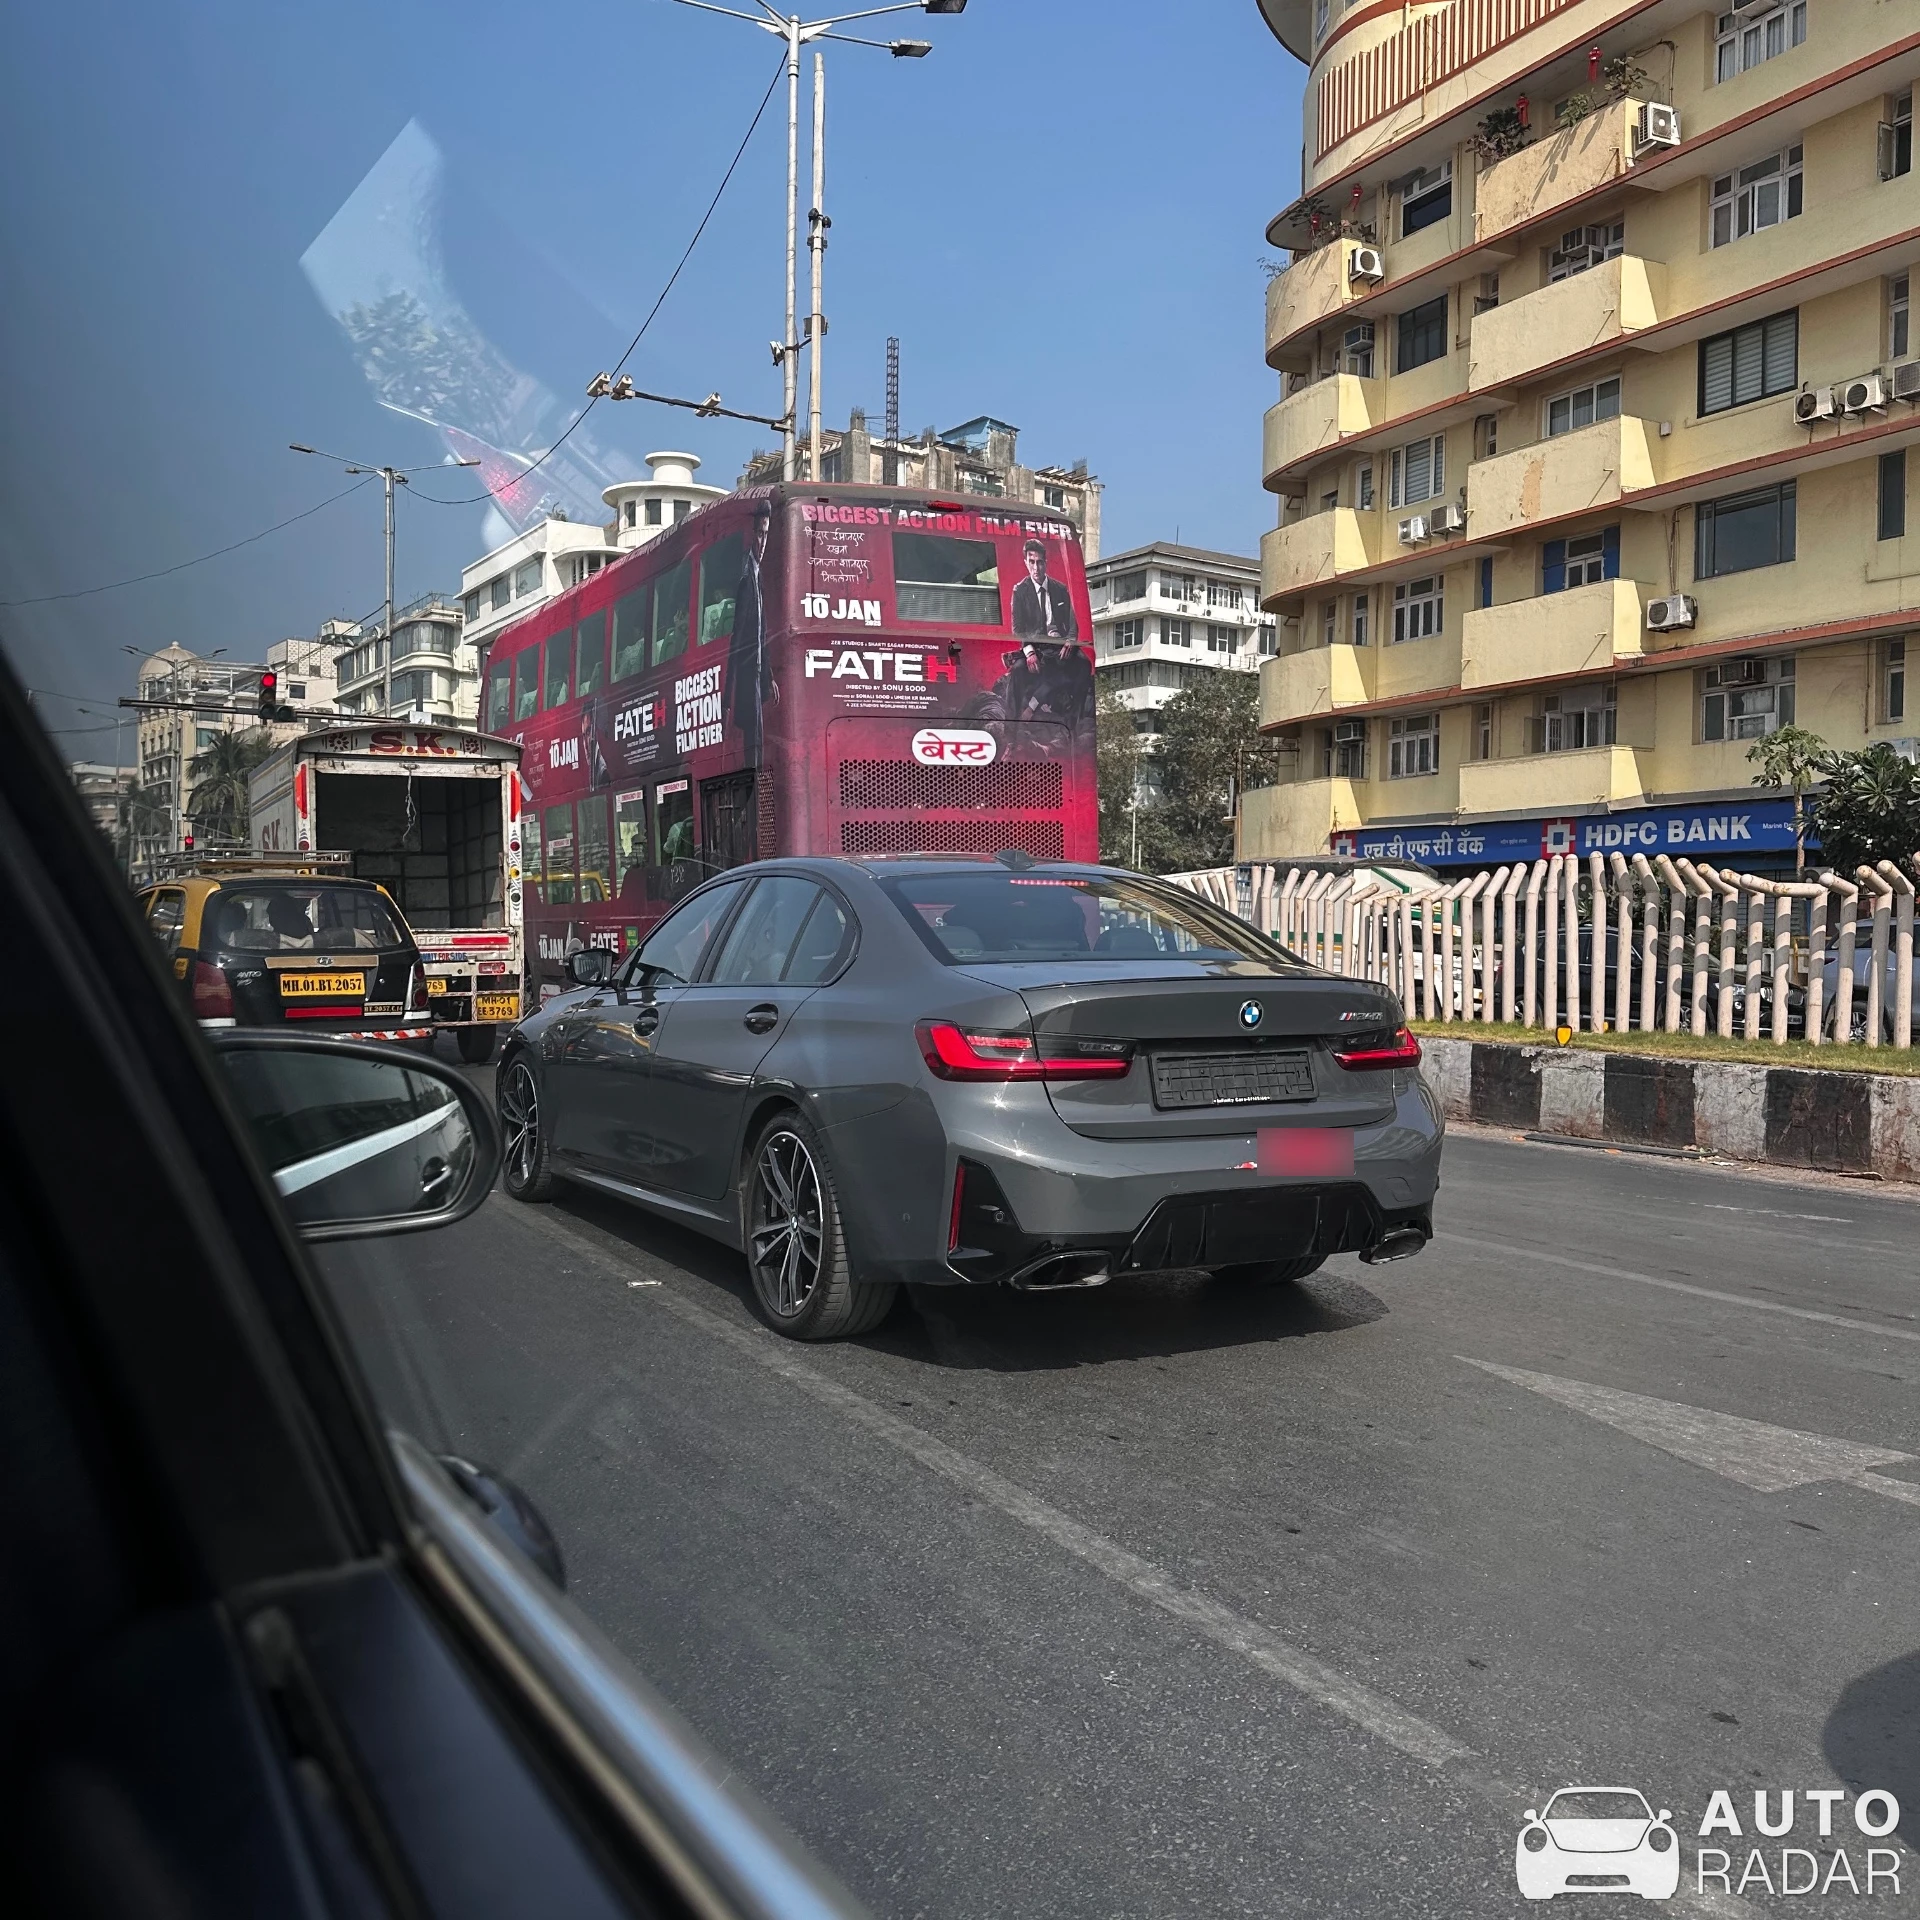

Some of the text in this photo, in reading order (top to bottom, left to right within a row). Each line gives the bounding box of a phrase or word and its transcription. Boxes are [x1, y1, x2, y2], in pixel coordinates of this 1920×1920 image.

[802, 504, 1073, 541] BIGGEST ACTION FILM EVER
[800, 597, 882, 621] 10 JAN
[905, 643, 940, 651] PRODUCTIONS
[805, 648, 958, 683] FATEH
[675, 664, 722, 705] BIGGEST
[882, 684, 904, 692] SONU
[676, 692, 722, 732] ACTION
[369, 730, 457, 755] S.K.
[676, 730, 698, 754] FILM
[699, 722, 723, 748] EVER
[917, 732, 992, 762] बेस्ट
[549, 743, 560, 769] 10
[560, 737, 579, 766] JAN
[1432, 831, 1454, 857] सी
[1585, 815, 1752, 848] HDFC BANK
[438, 952, 450, 961] FOR
[539, 938, 564, 960] 10 JAN
[282, 978, 362, 992] MH.01.BT.2057
